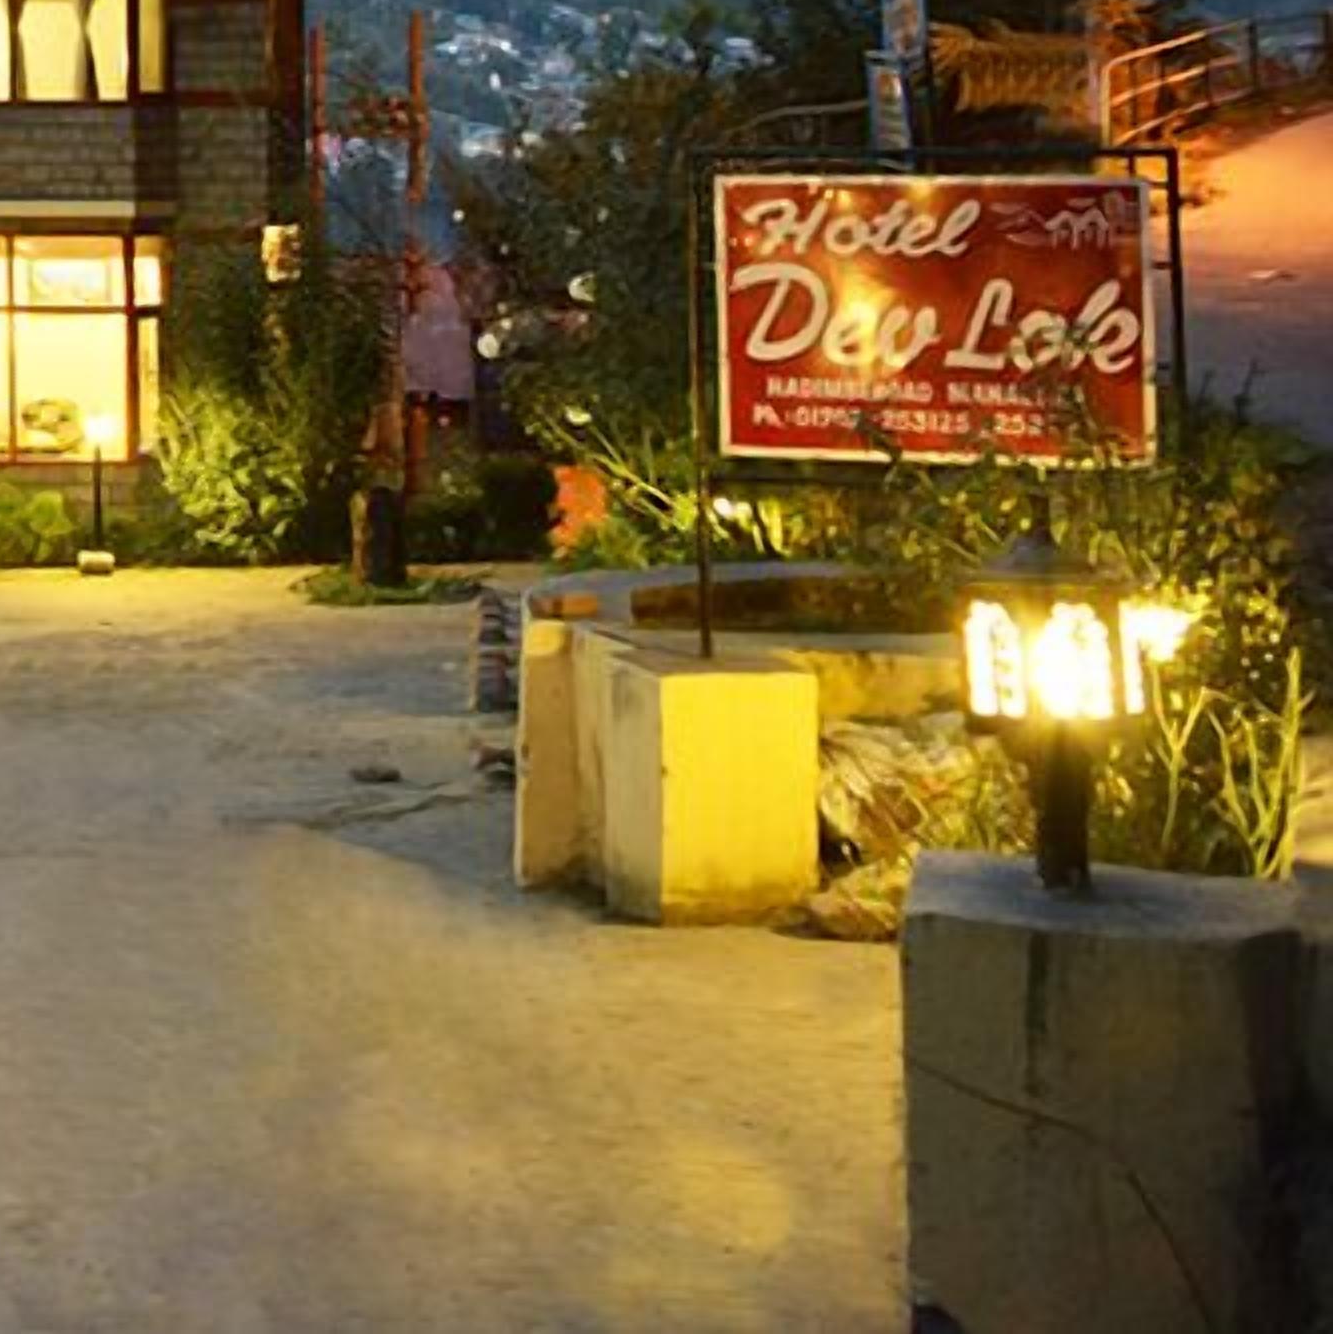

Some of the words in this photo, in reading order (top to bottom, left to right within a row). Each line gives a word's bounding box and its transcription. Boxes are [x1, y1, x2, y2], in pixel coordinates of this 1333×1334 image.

[742, 198, 982, 257] Hotel
[730, 262, 941, 367] Dev
[944, 277, 1141, 375] Lok
